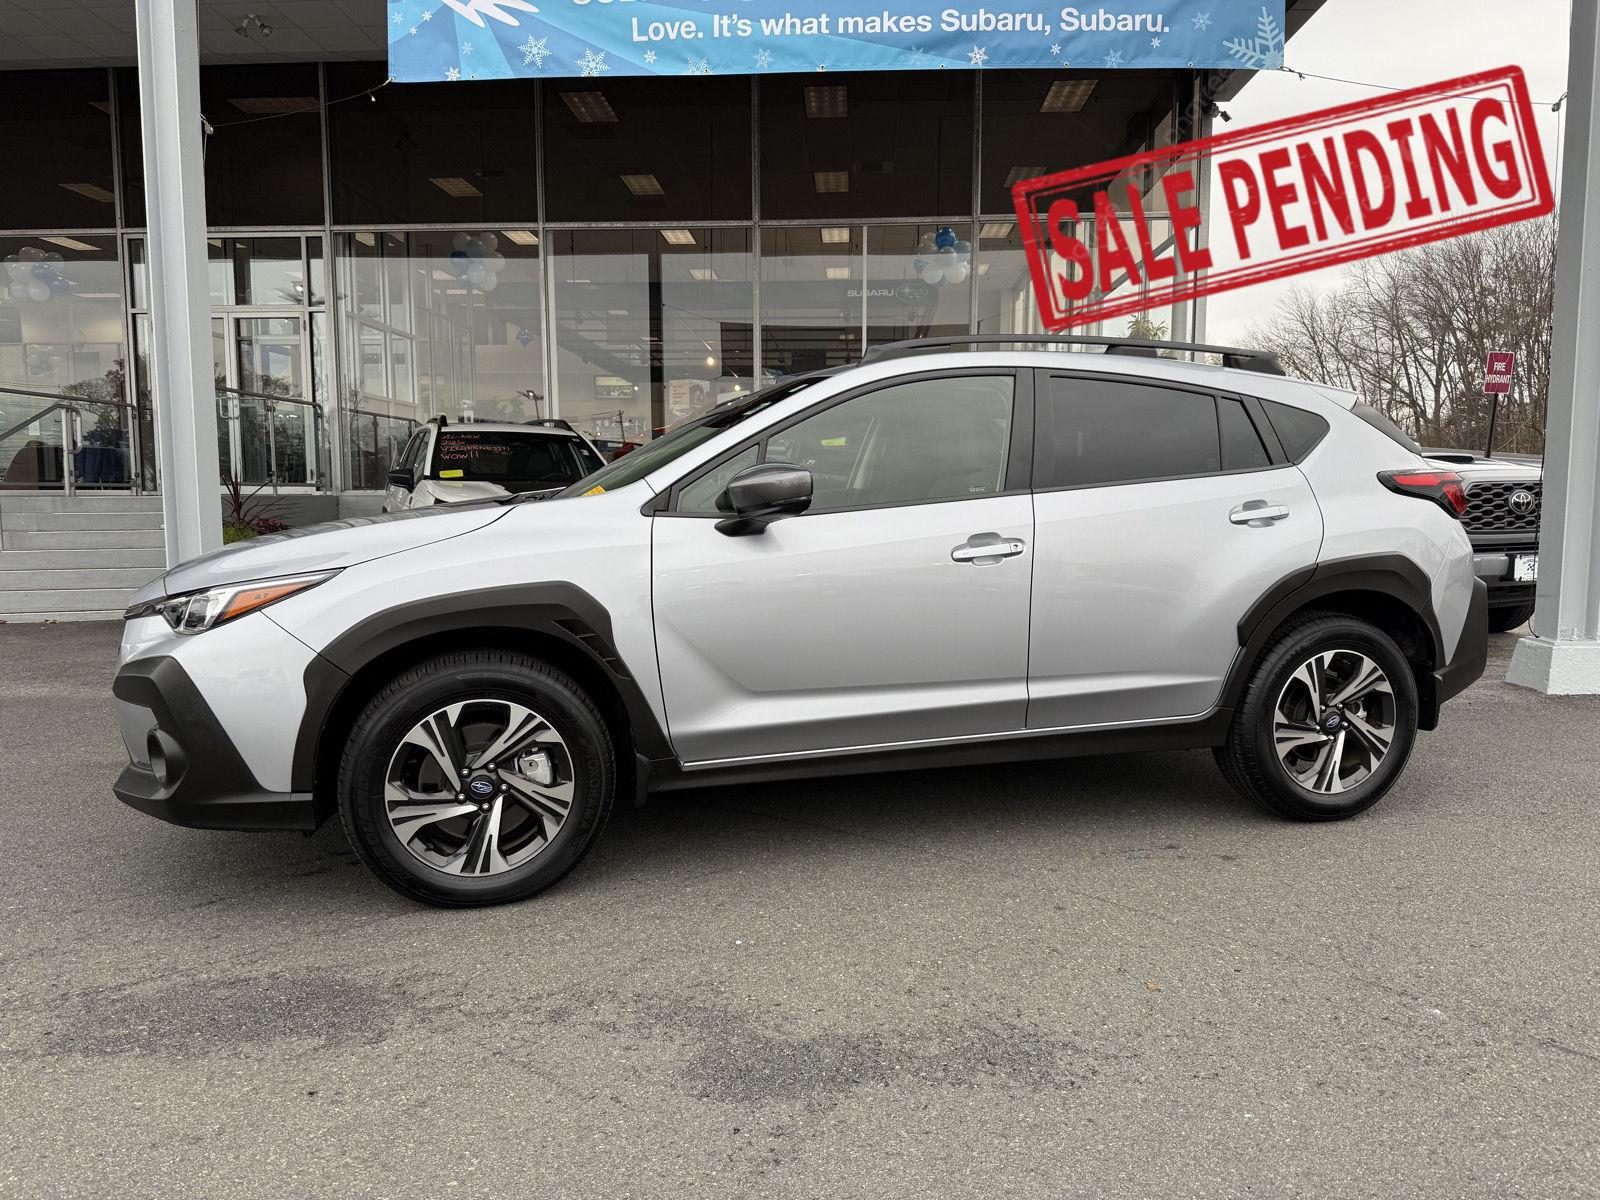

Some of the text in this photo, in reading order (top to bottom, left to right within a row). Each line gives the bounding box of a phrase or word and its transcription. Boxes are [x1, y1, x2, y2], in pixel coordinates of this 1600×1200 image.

[632, 8, 1169, 42] Love. It’s what makes Subaru, Subaru.
[1493, 361, 1507, 372] FIRE
[1485, 374, 1511, 384] HYDRANT
